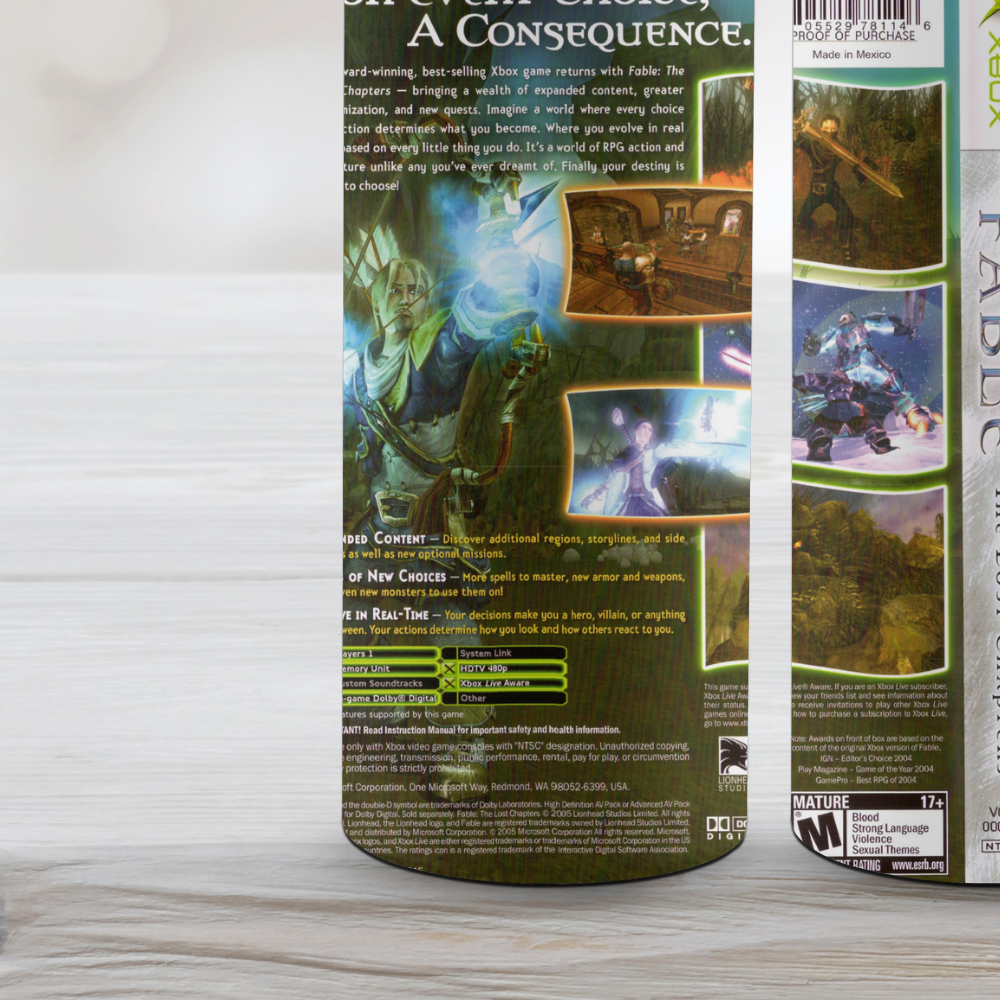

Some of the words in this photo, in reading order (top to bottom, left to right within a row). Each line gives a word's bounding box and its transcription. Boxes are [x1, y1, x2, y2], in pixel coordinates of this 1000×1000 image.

[407, 14, 443, 46] A
[457, 14, 750, 52] CONSEQUENCE.
[835, 31, 850, 40] OF
[856, 31, 915, 40] PURCHASE
[813, 50, 840, 59] Made
[845, 50, 853, 58] in
[857, 50, 891, 59] Mexico
[423, 66, 486, 80] best-selling
[491, 66, 518, 76] Xbox
[523, 69, 551, 79] game
[556, 68, 595, 76] returns
[601, 66, 623, 76] with
[629, 65, 660, 76] Fable:
[666, 65, 684, 75] The
[413, 85, 457, 99] bringing
[475, 85, 510, 95] wealth
[518, 85, 529, 95] of
[535, 85, 585, 97] expanded
[592, 86, 637, 96] content,
[644, 86, 684, 98] greater
[345, 182, 356, 191] to
[359, 180, 399, 190] choose!
[463, 572, 488, 583] More
[490, 572, 515, 584] spells
[519, 573, 529, 581] to
[533, 573, 568, 583] master,
[623, 571, 640, 581] and
[643, 574, 685, 583] weapons,
[460, 649, 491, 659] System
[494, 649, 513, 658] Link
[343, 666, 369, 674] emory
[488, 665, 508, 674] 480p
[369, 680, 422, 688] Soundtracks
[460, 679, 482, 687] Xbox
[485, 679, 502, 687] Live
[504, 679, 531, 687] Aware
[408, 695, 438, 704] Digital
[460, 693, 487, 702] Other
[798, 766, 812, 774] Play
[814, 766, 848, 774] Magazine
[856, 765, 876, 773] Game
[816, 776, 848, 784] GamePro
[857, 776, 872, 784] Best
[873, 776, 888, 784] RPG
[409, 783, 426, 791] One
[429, 783, 467, 792] Microsoft
[469, 783, 488, 793] Way,
[535, 782, 548, 790] WA
[551, 782, 608, 792] 98052-6399,
[611, 782, 630, 791] USA.
[793, 795, 849, 809] MATURE
[921, 795, 945, 809] 17+
[852, 813, 879, 822] Blood
[796, 811, 842, 852] M
[852, 823, 883, 835] Strong
[885, 823, 929, 835] Language
[852, 834, 892, 843] Violence
[853, 845, 883, 854] Sexual
[885, 845, 919, 854] Themes
[892, 858, 945, 872] www.esrb.org
